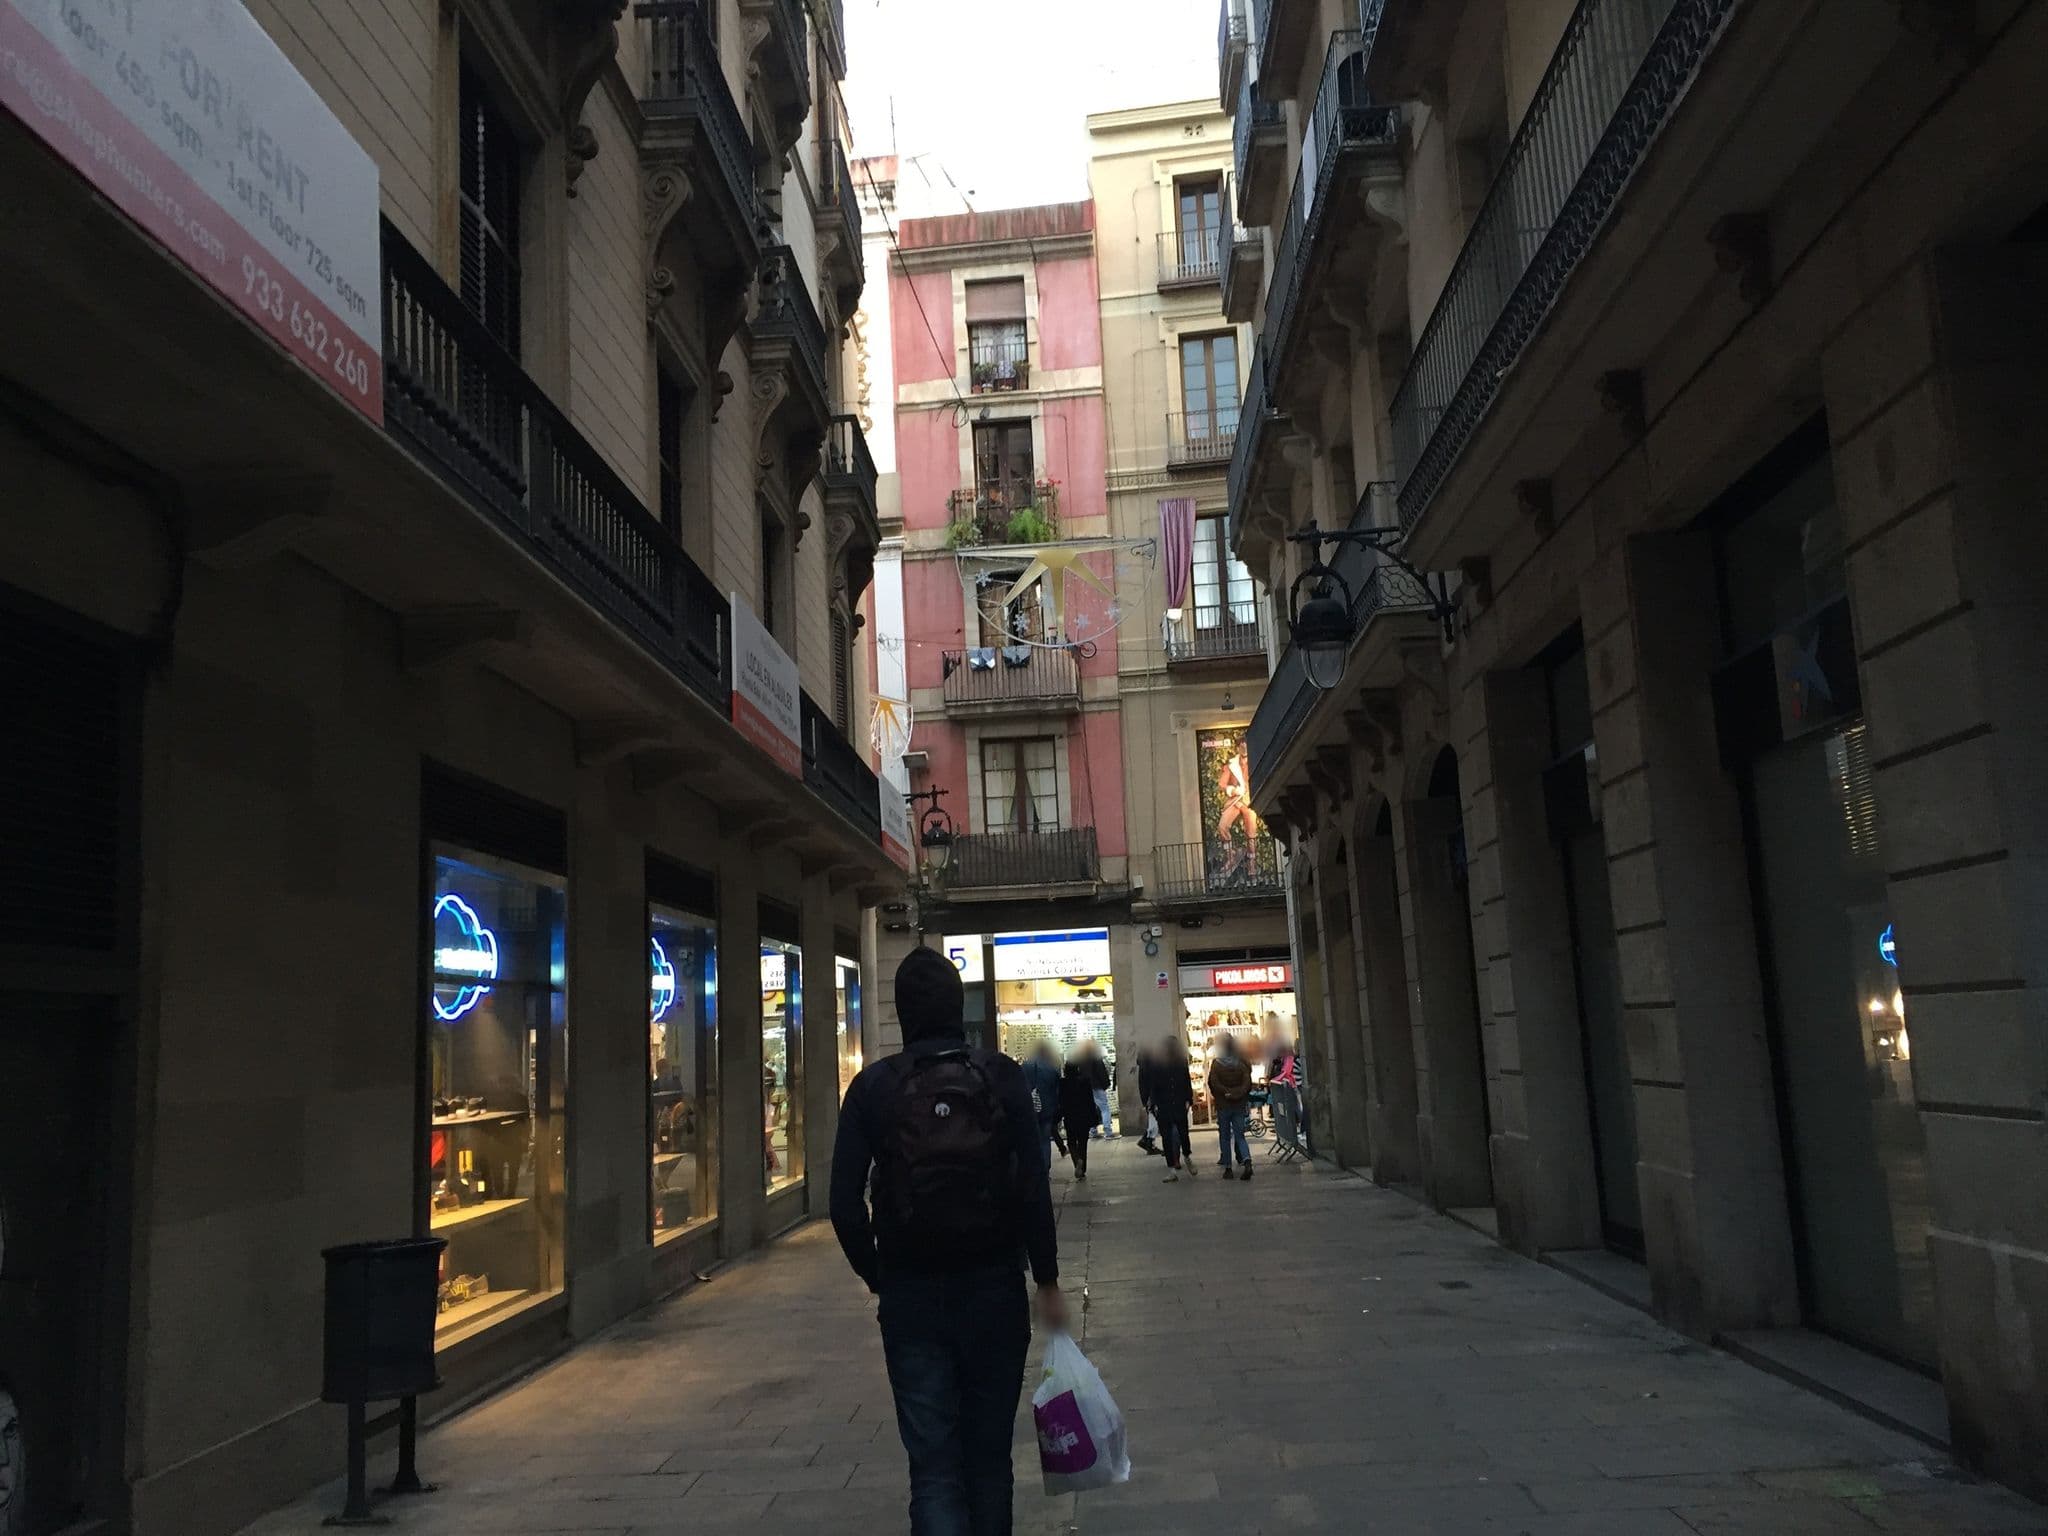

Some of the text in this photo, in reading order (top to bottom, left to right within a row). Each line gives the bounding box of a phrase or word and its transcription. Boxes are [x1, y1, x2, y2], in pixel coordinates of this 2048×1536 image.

[161, 101, 203, 158] sqm
[258, 191, 301, 249] Floor
[305, 238, 332, 286] 725
[336, 276, 366, 318] sqm
[238, 107, 311, 214] RENT
[242, 253, 284, 323] 933
[289, 301, 328, 364] 632
[333, 337, 368, 396] 260
[950, 948, 967, 971] 5
[1215, 967, 1267, 984] PIKOLINOS
